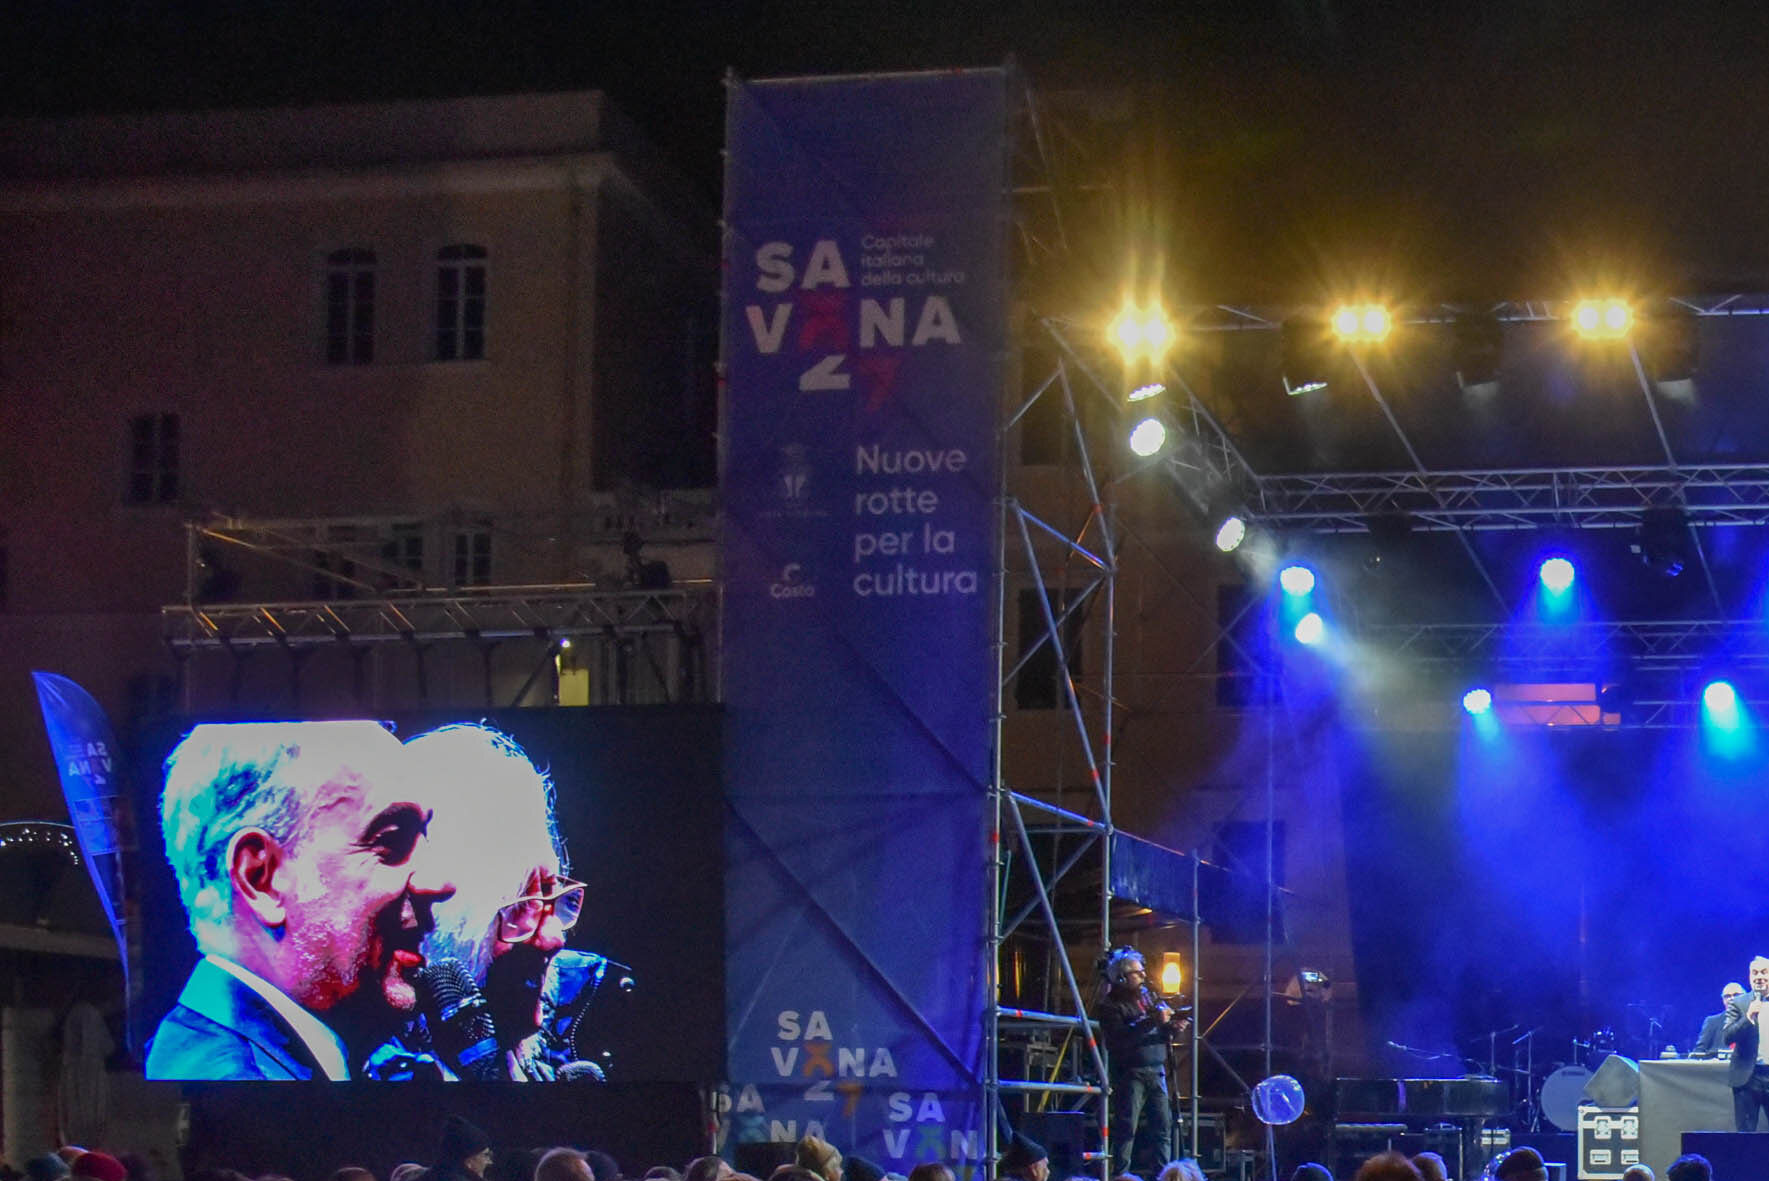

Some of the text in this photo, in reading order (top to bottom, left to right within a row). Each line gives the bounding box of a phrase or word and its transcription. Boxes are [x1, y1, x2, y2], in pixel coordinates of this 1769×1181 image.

[860, 233, 935, 254] Capitale
[754, 239, 851, 294] SA
[860, 252, 925, 267] italiana
[860, 267, 966, 287] della cultura
[855, 443, 968, 475] Nuove
[854, 486, 939, 516] rotte
[854, 521, 956, 564] per la
[769, 583, 816, 600] Costa
[852, 562, 978, 597] cultura
[776, 1010, 833, 1041] SA
[887, 1091, 947, 1123] SA
